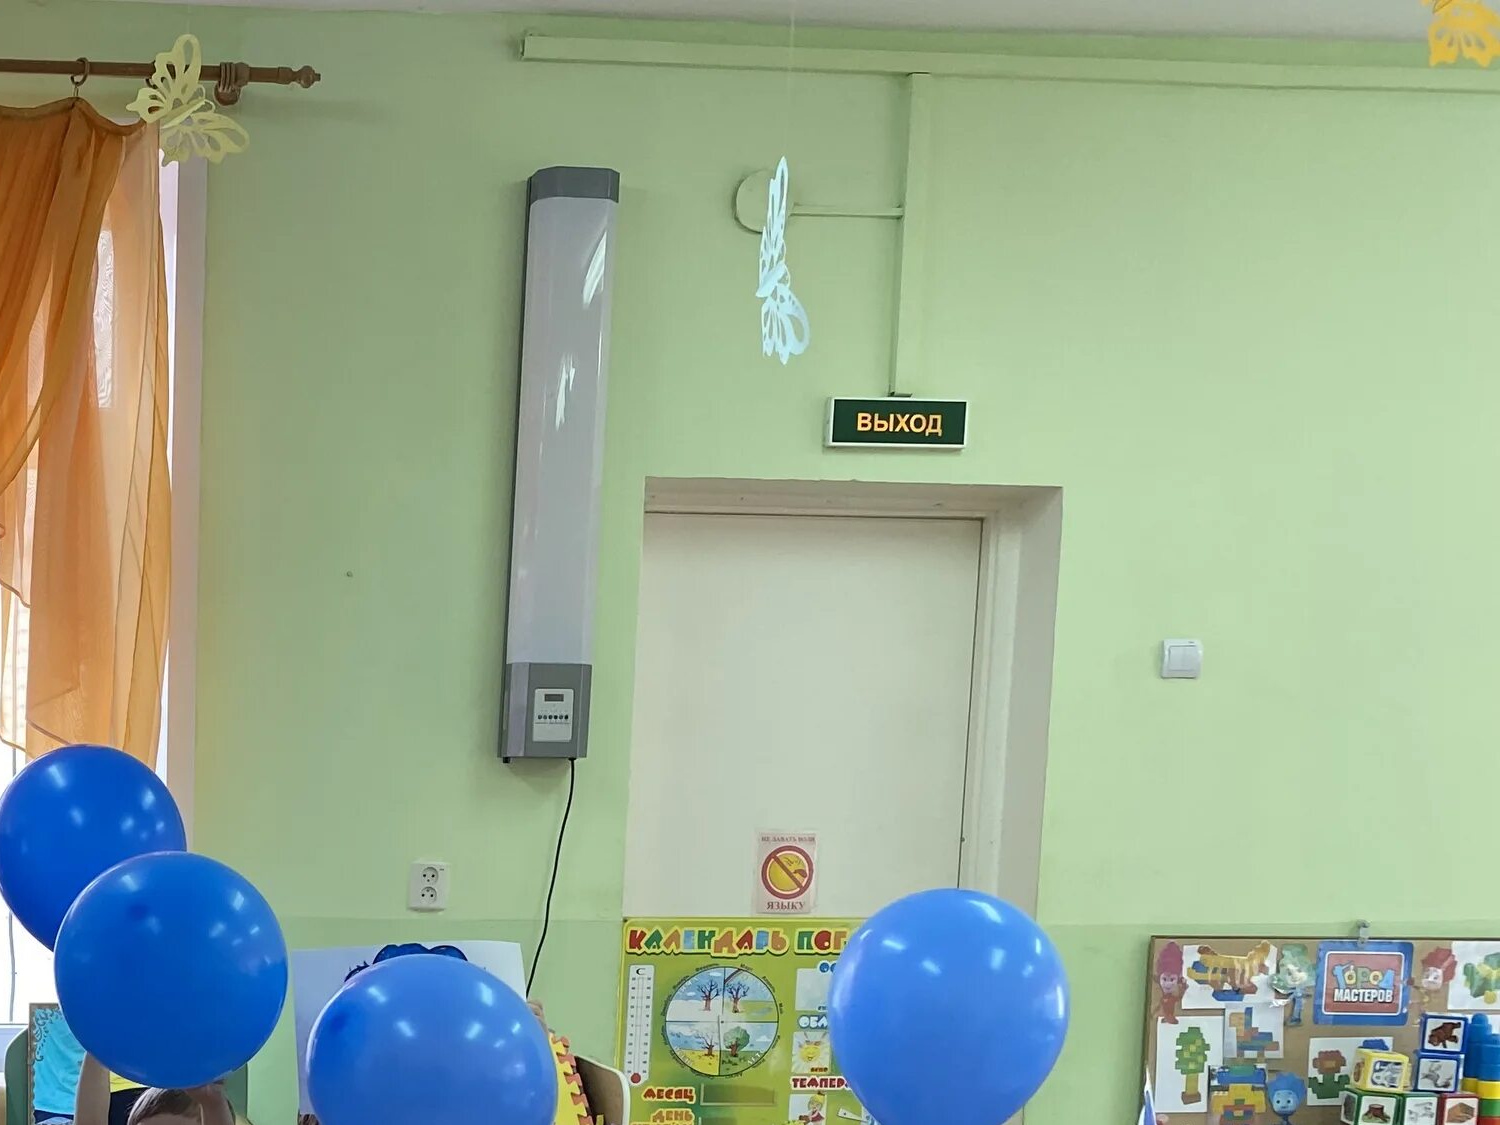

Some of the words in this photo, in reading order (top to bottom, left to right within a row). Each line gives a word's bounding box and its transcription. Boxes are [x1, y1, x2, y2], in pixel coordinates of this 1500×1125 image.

[857, 413, 942, 436] ВЫХОД
[766, 901, 805, 910] ЯЗЫКУ
[629, 929, 787, 954] КАЛЕНДАРЬ
[798, 930, 849, 950] ПОГ
[1333, 988, 1394, 1002] МАСТЕРОВ
[792, 1077, 850, 1088] ТЕМПЕР
[643, 1088, 694, 1102] МЕСЯЦ
[652, 1110, 694, 1122] ДЕНЬ
